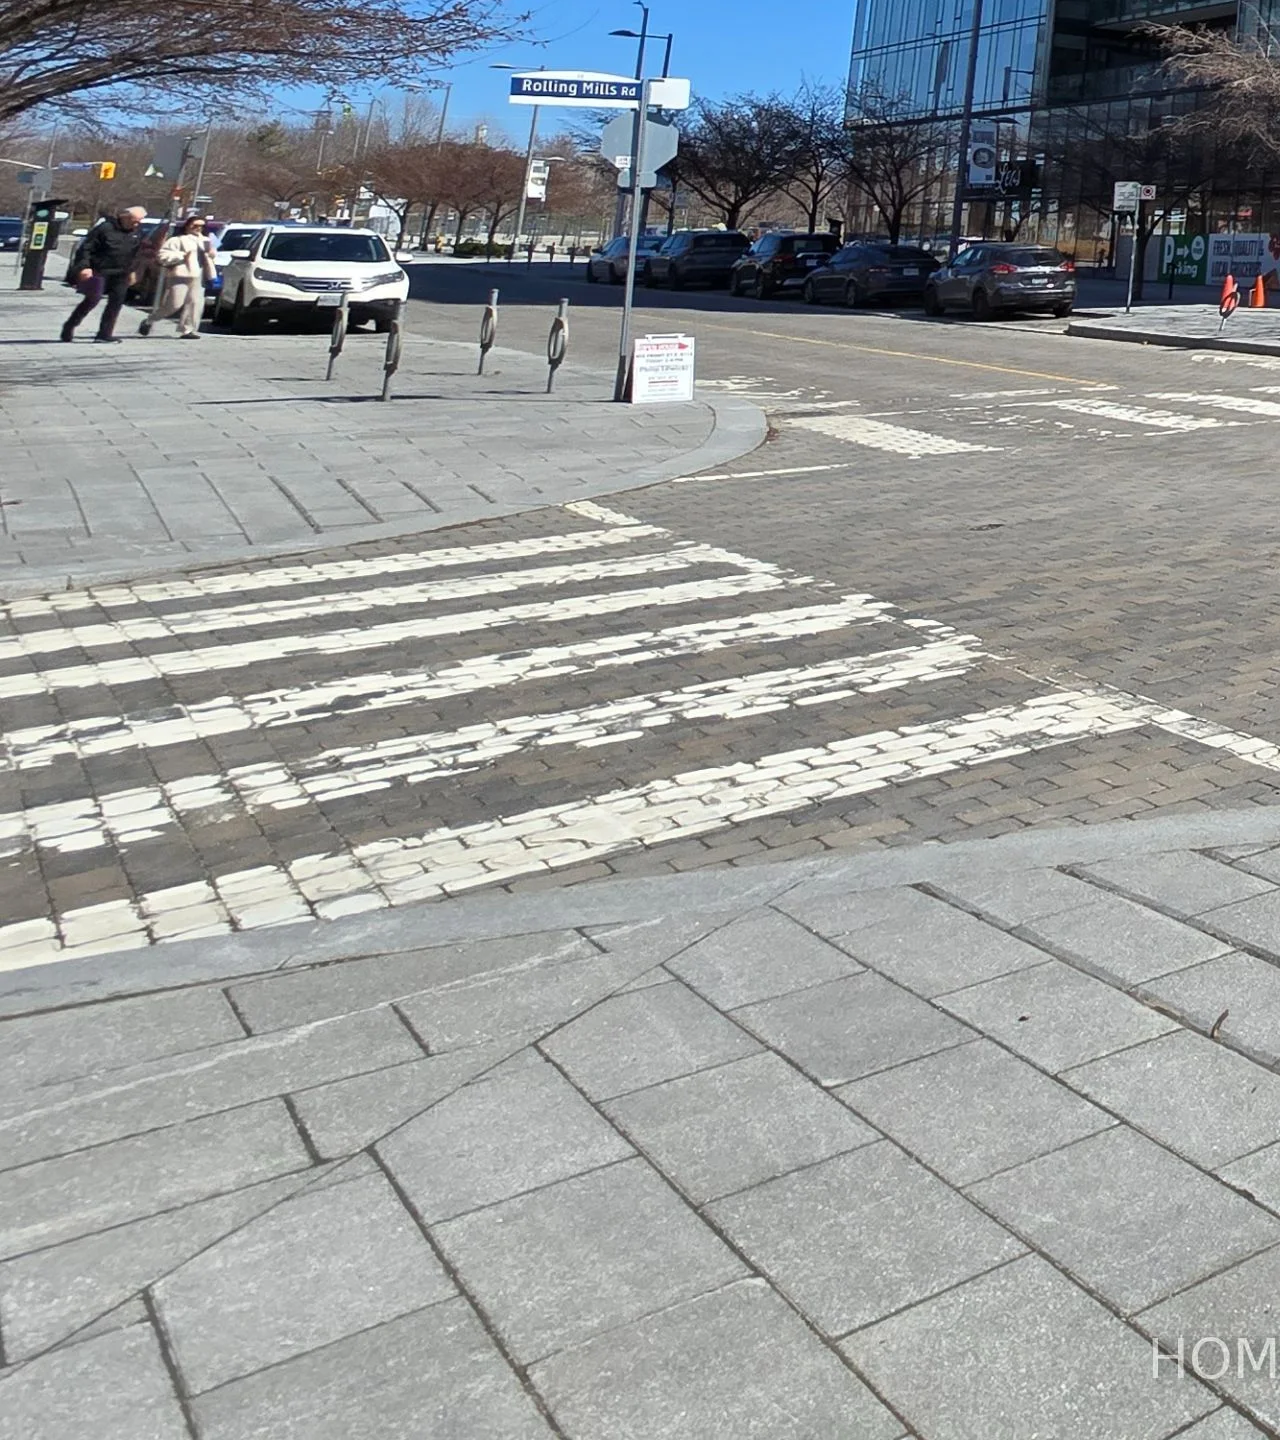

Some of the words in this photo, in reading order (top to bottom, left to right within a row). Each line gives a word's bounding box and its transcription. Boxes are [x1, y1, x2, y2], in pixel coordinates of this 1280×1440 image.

[522, 78, 578, 96] Rolling
[582, 82, 617, 96] Mills
[621, 86, 636, 96] Rd
